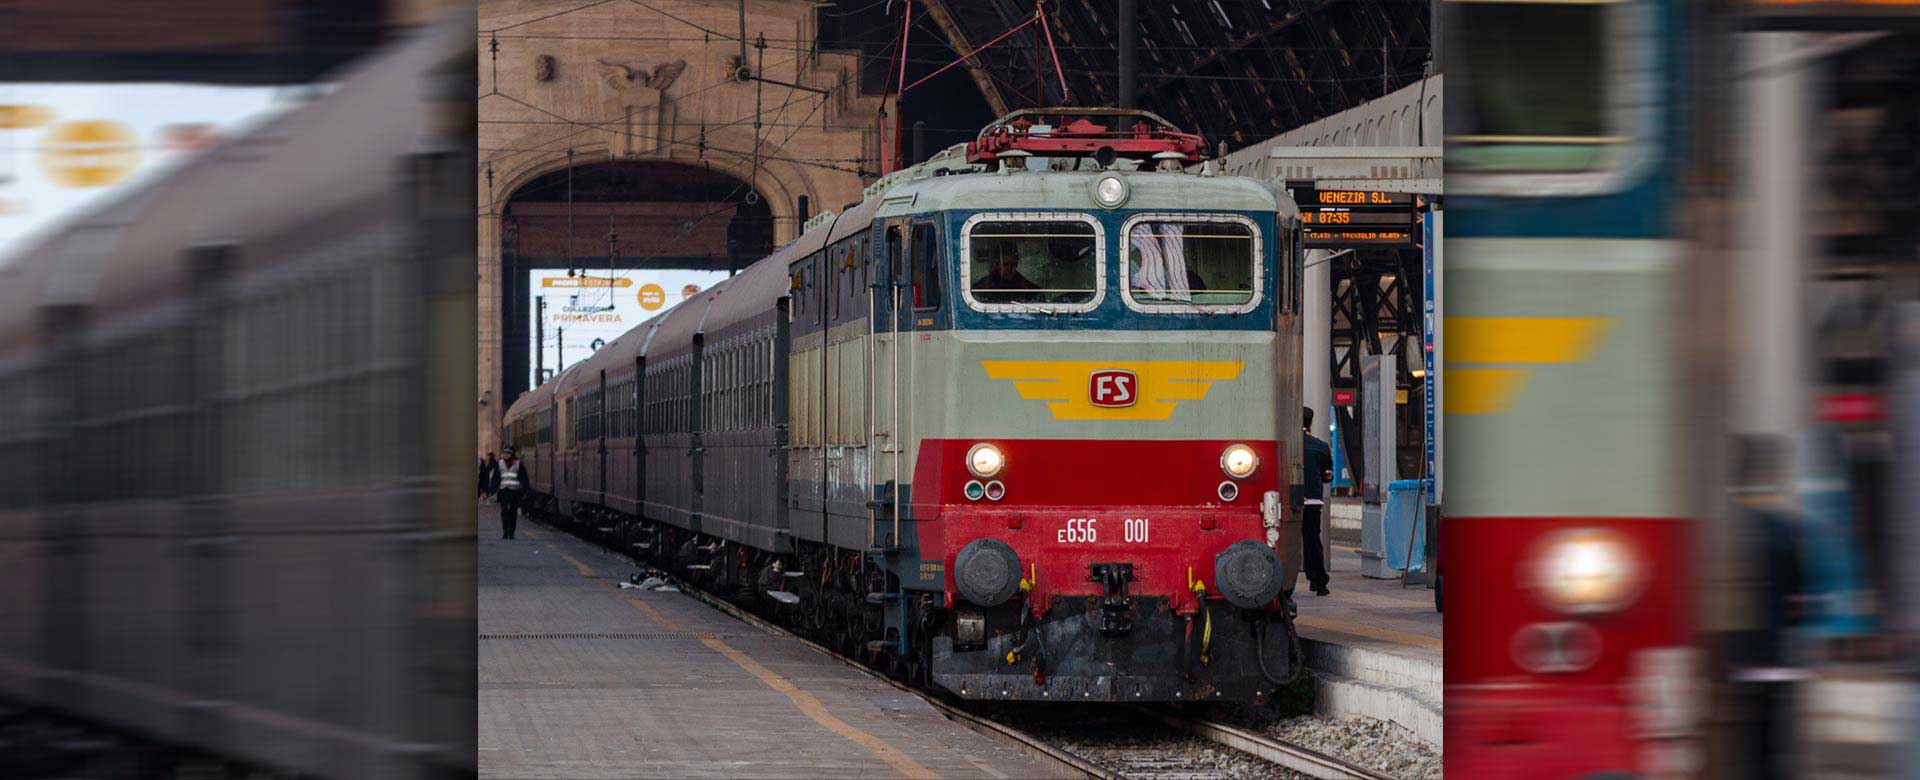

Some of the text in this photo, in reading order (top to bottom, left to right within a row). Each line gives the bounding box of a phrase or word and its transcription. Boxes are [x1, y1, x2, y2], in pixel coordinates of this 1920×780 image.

[1319, 192, 1392, 204] VENEZIA S.L.
[1319, 212, 1350, 224] 07:35
[553, 313, 622, 322] PRIMAVERA
[1096, 375, 1130, 402] FS
[1124, 518, 1149, 543] 001
